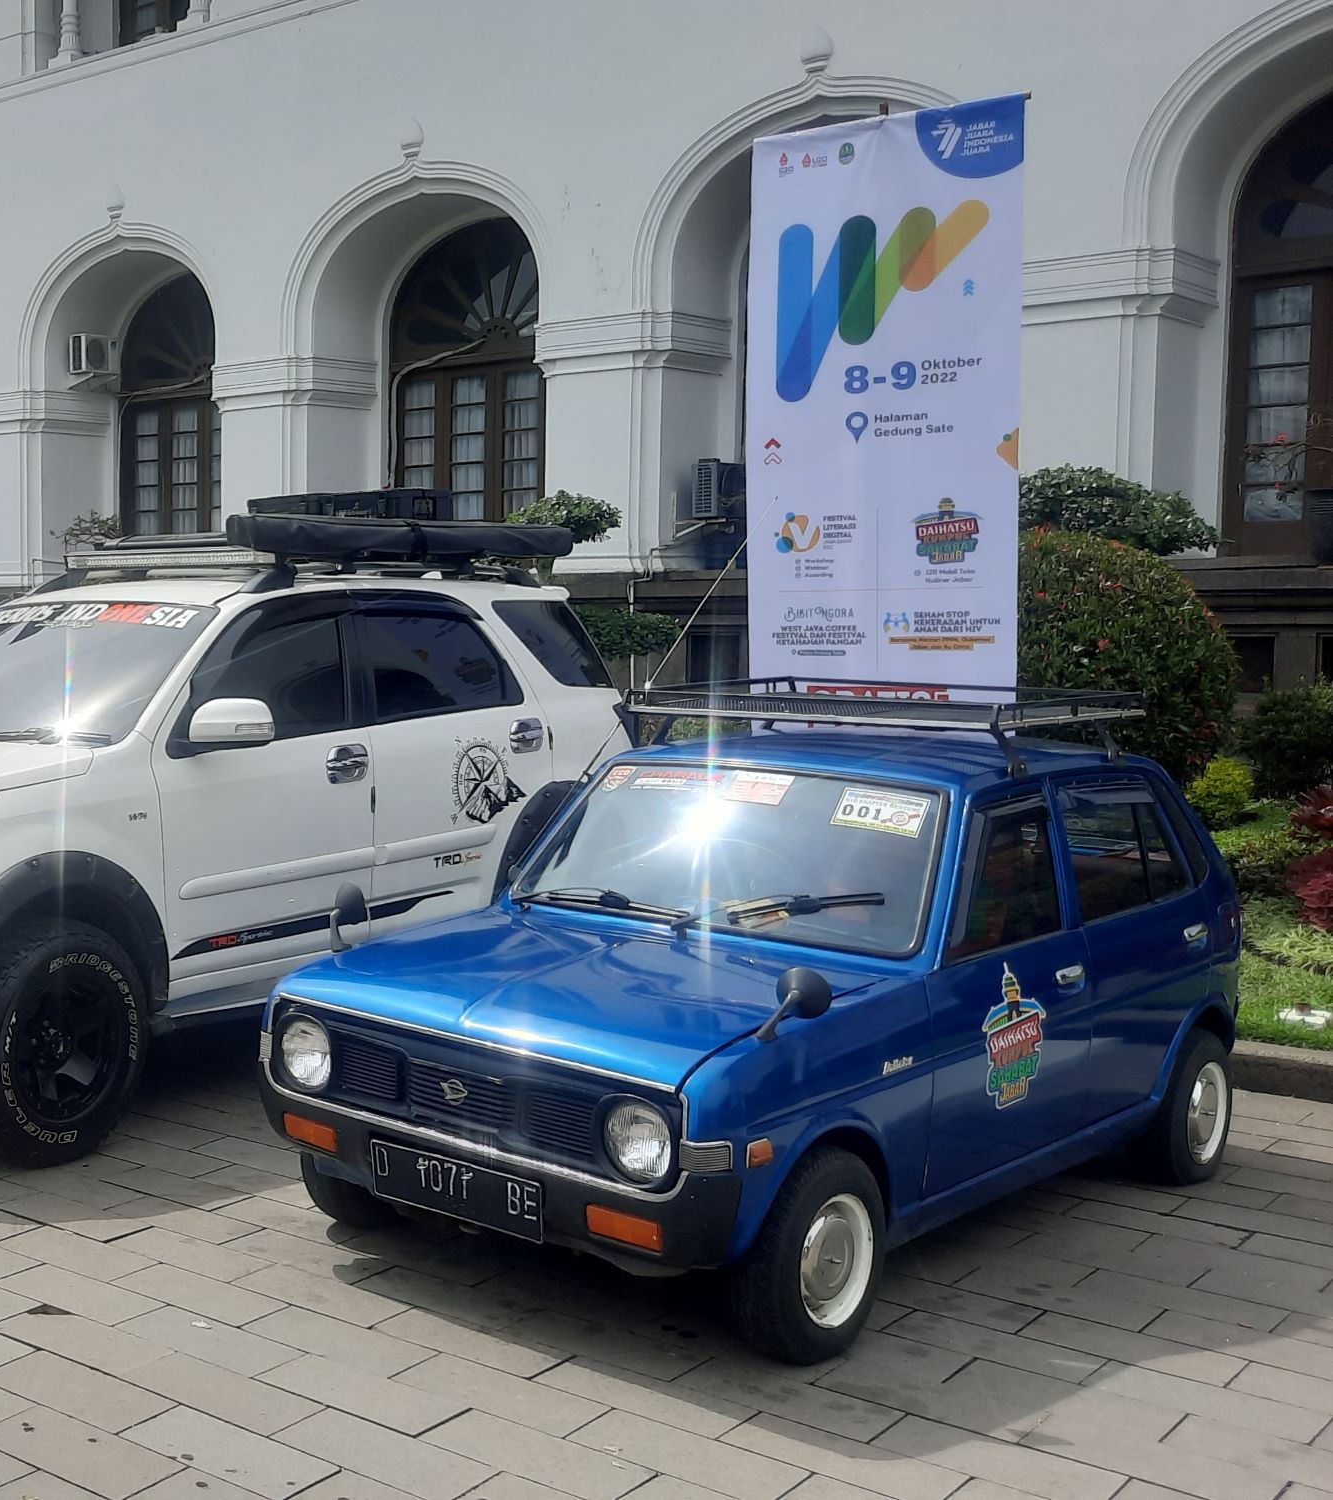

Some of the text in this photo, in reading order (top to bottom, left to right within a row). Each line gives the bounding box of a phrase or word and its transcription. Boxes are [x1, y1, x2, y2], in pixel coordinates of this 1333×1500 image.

[963, 134, 1014, 148] INDONESIA
[964, 129, 994, 140] JUARA
[960, 145, 990, 156] JUARA
[921, 357, 982, 371] Oktober
[921, 372, 958, 385] 2022
[874, 412, 928, 423] Halaman
[874, 424, 954, 437] Gedung Sate
[823, 514, 857, 522] FESTIVAL
[918, 520, 975, 537] DAIHATSU
[55, 603, 200, 629] INDONESIA
[946, 610, 970, 618] STOP
[841, 803, 882, 821] 001
[433, 853, 461, 868] TRD
[210, 935, 237, 948] TRD
[48, 952, 139, 1061] BRIDGESTONE
[989, 1020, 1038, 1054] DAIHATSU
[999, 1076, 1027, 1102] JABAR
[374, 1146, 389, 1176] D
[506, 1181, 538, 1221] BE
